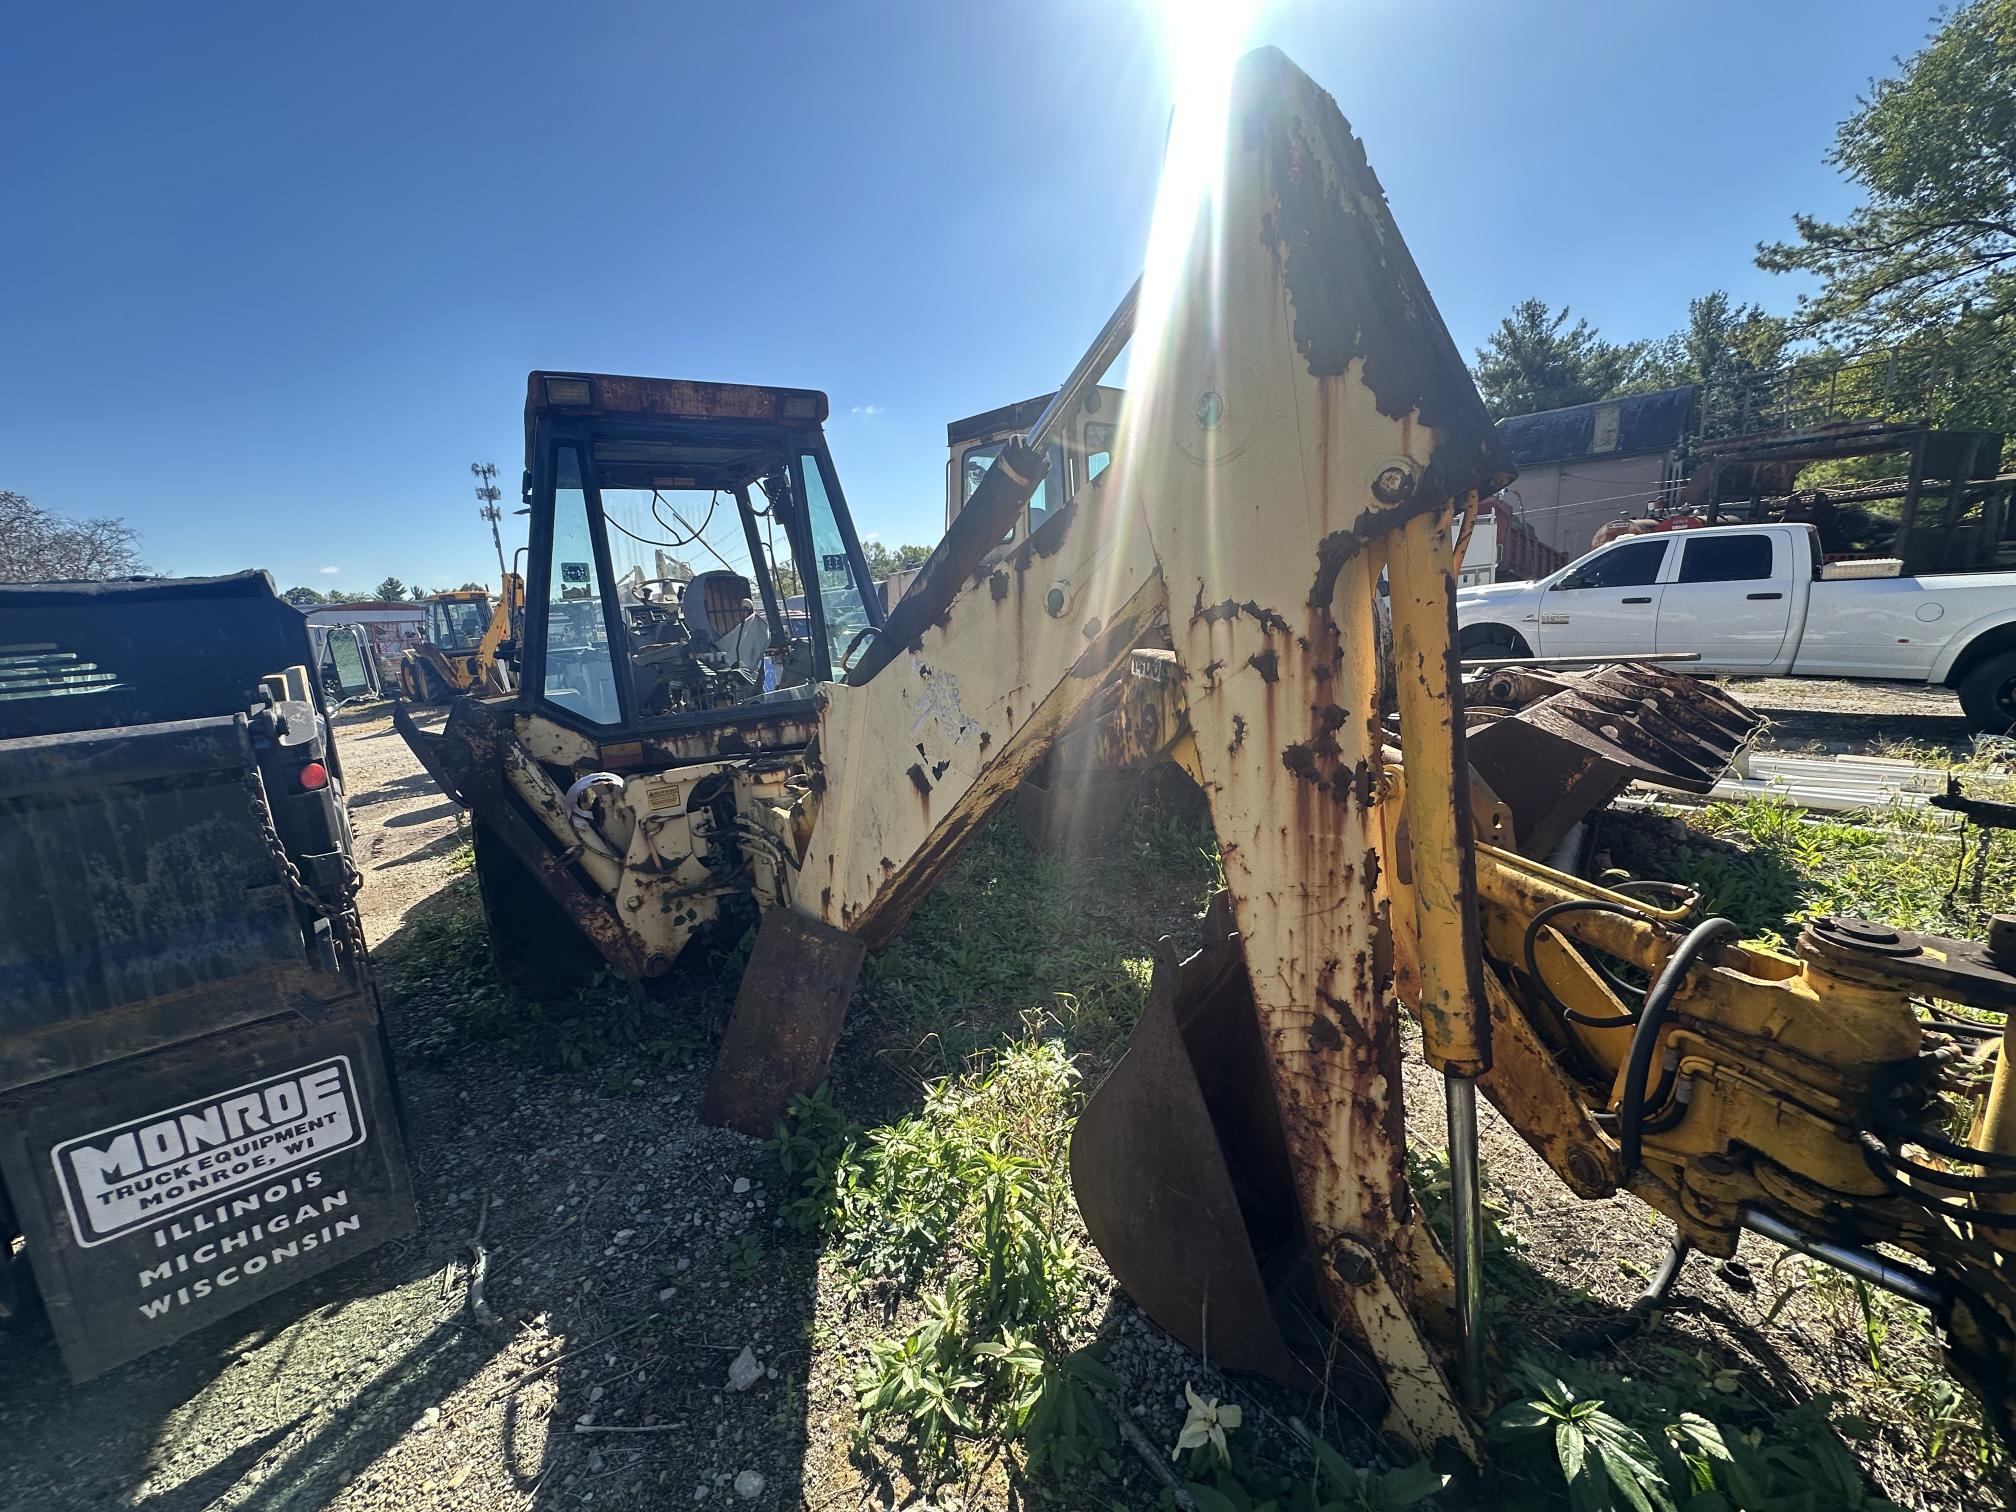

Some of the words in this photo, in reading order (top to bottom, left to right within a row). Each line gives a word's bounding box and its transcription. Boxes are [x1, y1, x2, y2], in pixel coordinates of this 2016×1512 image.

[69, 1066, 347, 1194] MONROE
[97, 1163, 191, 1206] TRUCK
[198, 1112, 337, 1170] EQUIPMENT
[138, 1154, 276, 1210] MONROE,
[284, 1137, 314, 1155] WI
[139, 1190, 348, 1288] MICHIGAN
[154, 1171, 322, 1247] ILLINOIS
[139, 1214, 361, 1320] WISCONSIN
